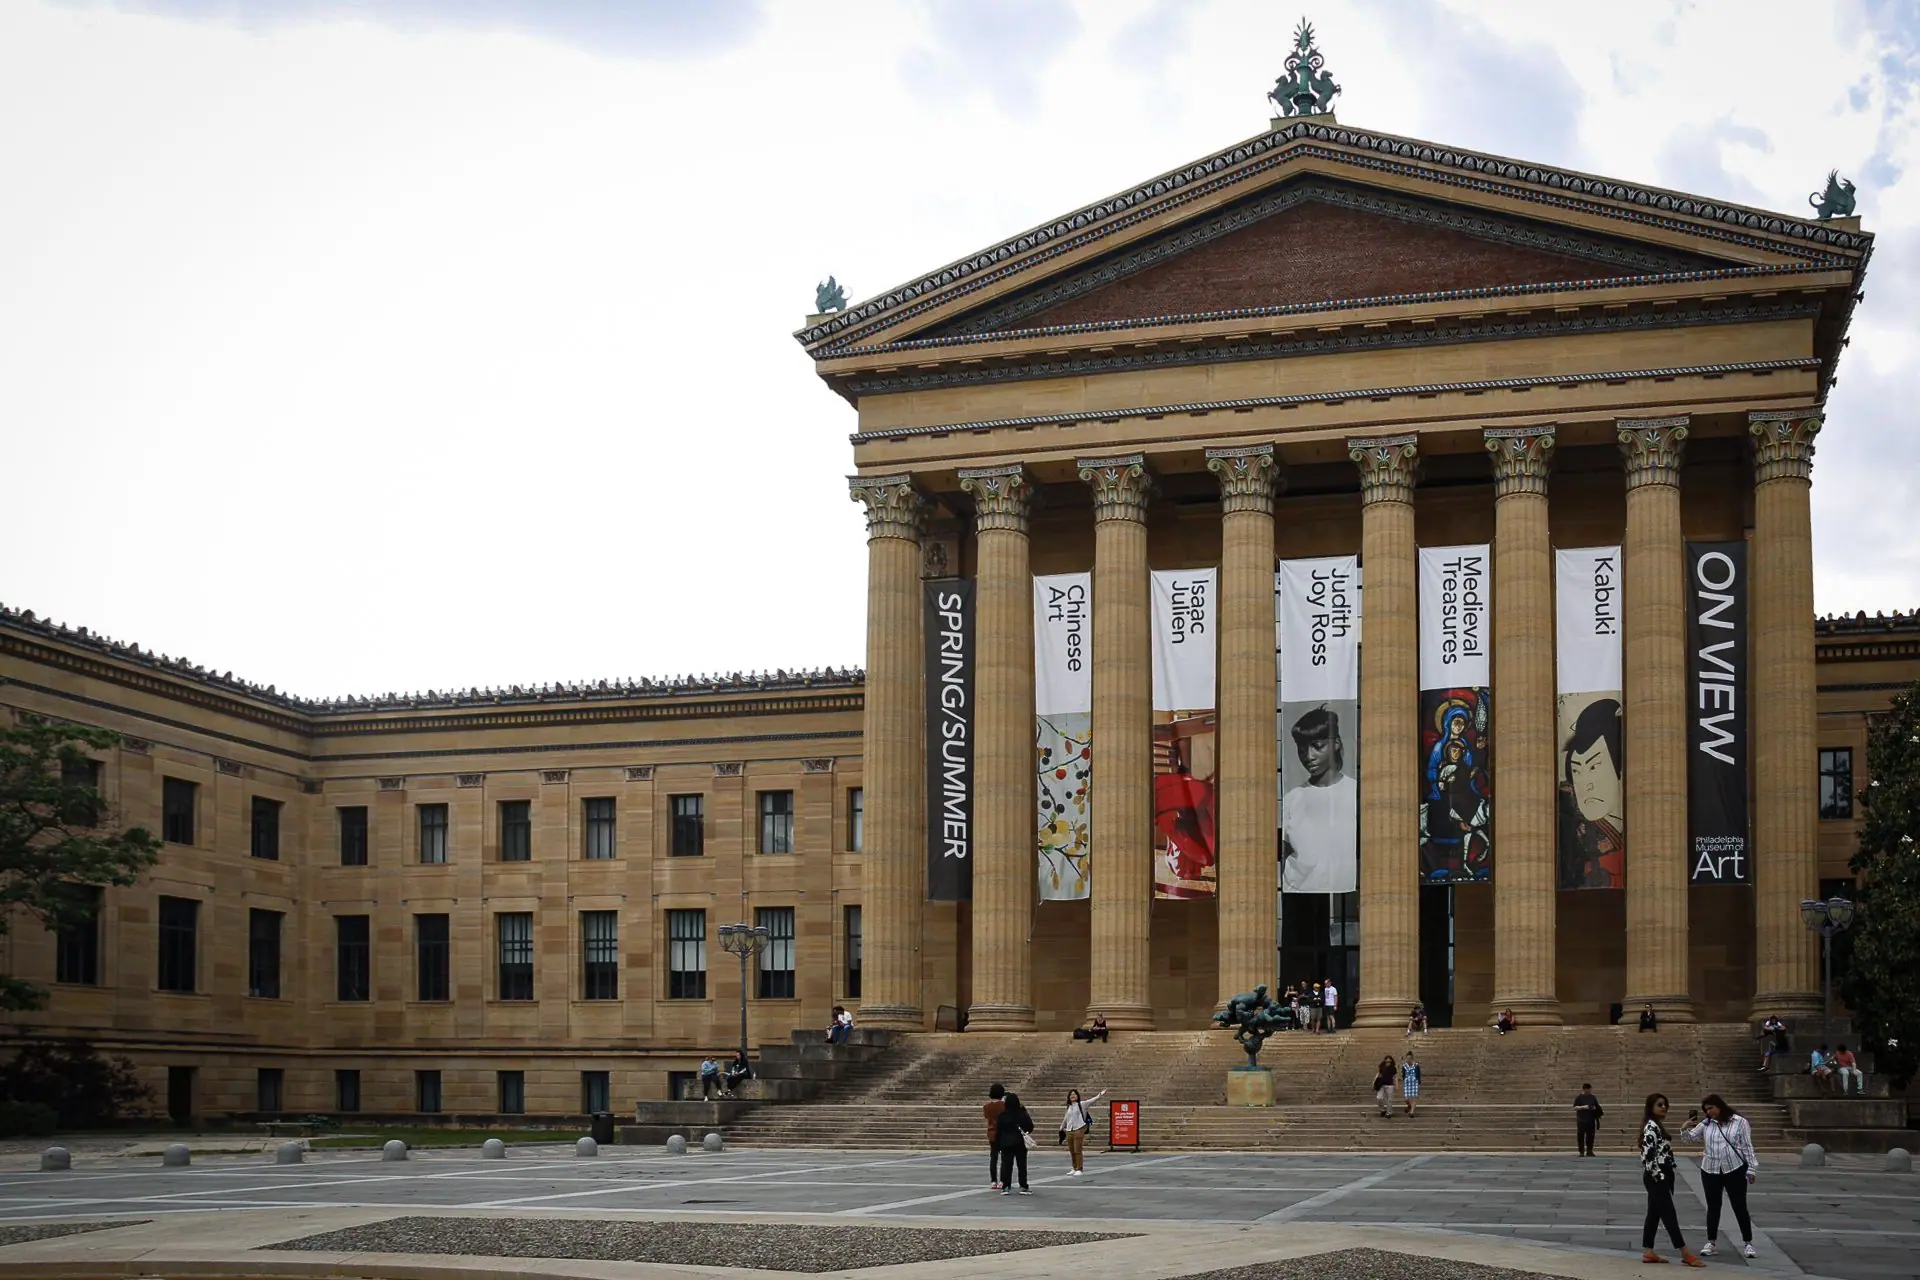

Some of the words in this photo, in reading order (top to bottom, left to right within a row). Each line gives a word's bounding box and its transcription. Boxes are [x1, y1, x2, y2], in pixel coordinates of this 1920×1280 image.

[1048, 586, 1065, 622] Art
[1171, 580, 1187, 644] Julien
[1190, 579, 1209, 634] Isaac
[1306, 569, 1330, 608] Joy
[1331, 567, 1352, 638] Judith
[1442, 556, 1462, 665] Treasures
[1463, 556, 1484, 657] Medieval
[1594, 557, 1616, 635] Kabuki
[1697, 551, 1736, 630] ON
[1066, 584, 1086, 672] Chinese
[1311, 613, 1327, 667] Ross
[938, 591, 967, 859] SPRING/SUMMER
[1698, 640, 1735, 766] VIEW
[1692, 850, 1745, 880] Art
[1695, 836, 1744, 844] Philadelphia
[1734, 843, 1744, 851] of
